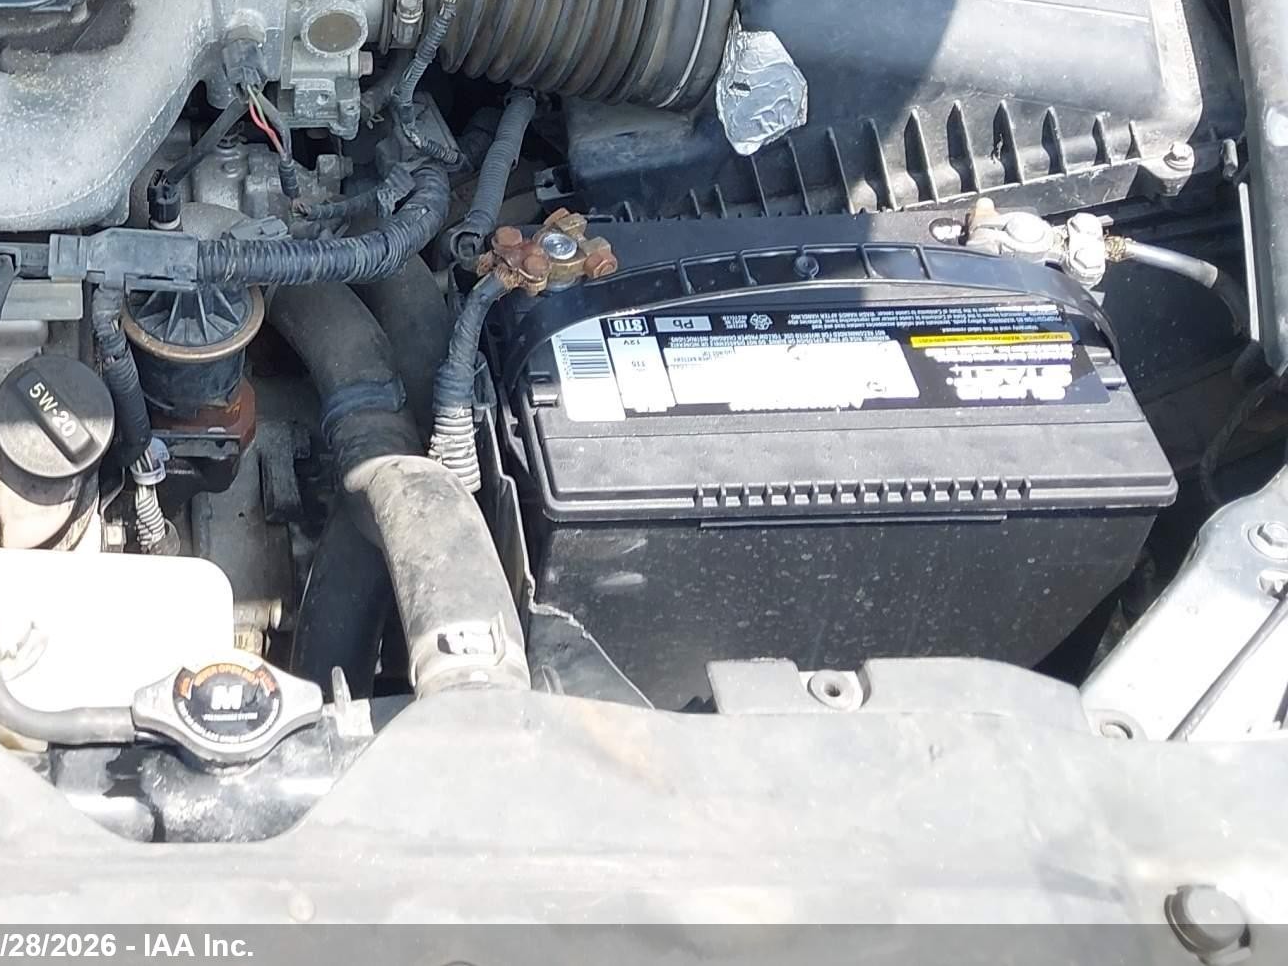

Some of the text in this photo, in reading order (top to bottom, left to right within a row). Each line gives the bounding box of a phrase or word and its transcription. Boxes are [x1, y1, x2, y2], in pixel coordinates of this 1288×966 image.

[613, 319, 643, 331] STD
[672, 319, 694, 329] Pb
[29, 382, 77, 438] 5W-20
